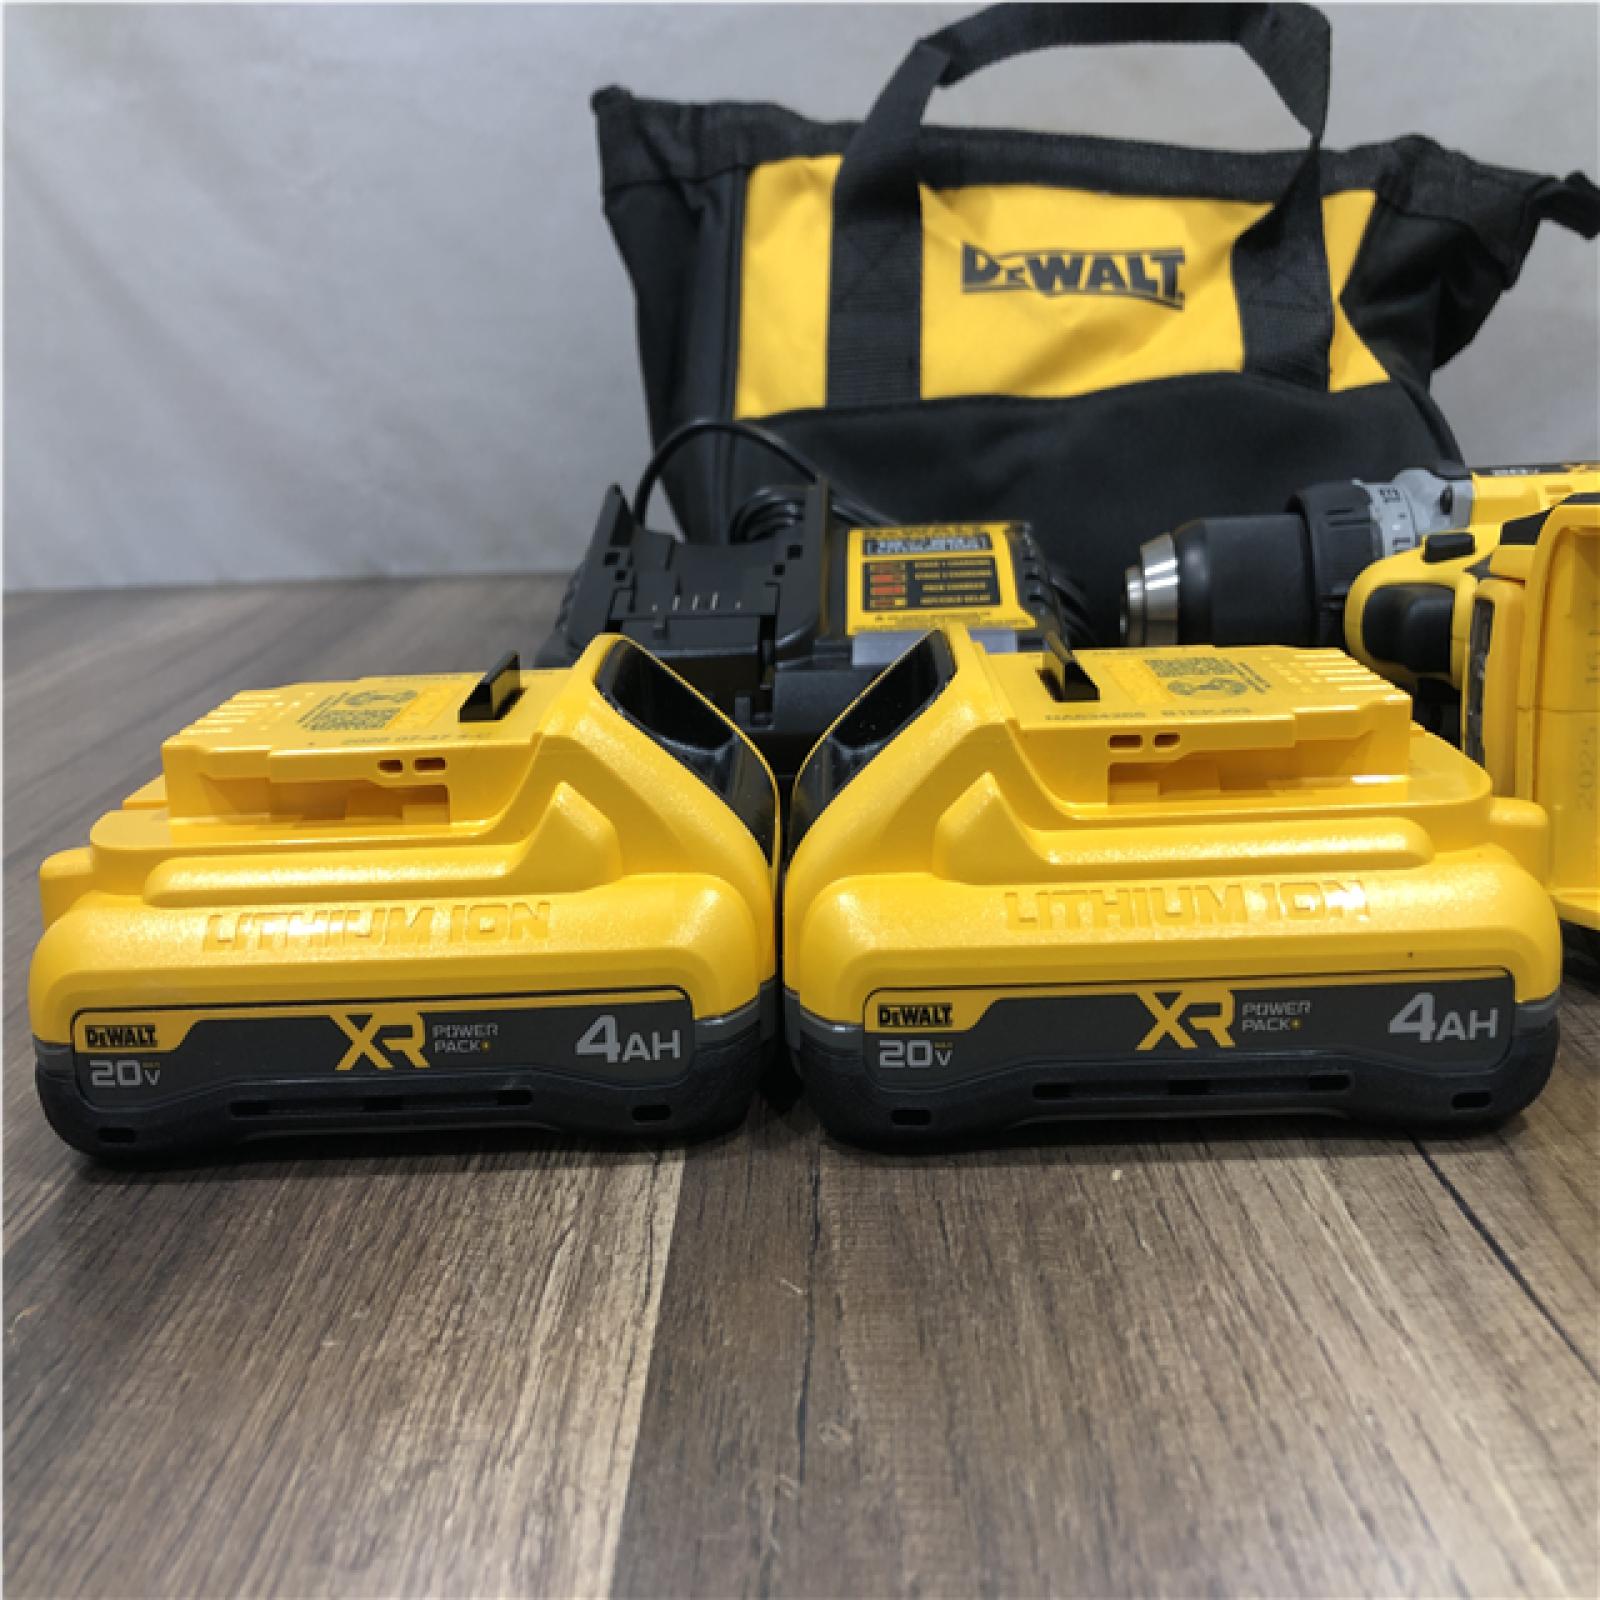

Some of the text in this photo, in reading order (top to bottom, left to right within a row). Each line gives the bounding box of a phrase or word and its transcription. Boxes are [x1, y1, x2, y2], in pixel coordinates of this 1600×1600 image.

[962, 241, 1185, 309] DEWALT
[203, 901, 551, 951] LITHIUM ION
[1004, 879, 1369, 931] LITHIUM ION
[431, 1023, 499, 1039] POWER
[877, 1003, 953, 1028] DEWALT
[1136, 989, 1235, 1051] XR
[1241, 1000, 1311, 1016] POWER
[1388, 992, 1498, 1043] 4AH
[85, 1025, 158, 1048] DEWALT
[330, 1009, 430, 1071] XR
[575, 1014, 681, 1063] 4AH
